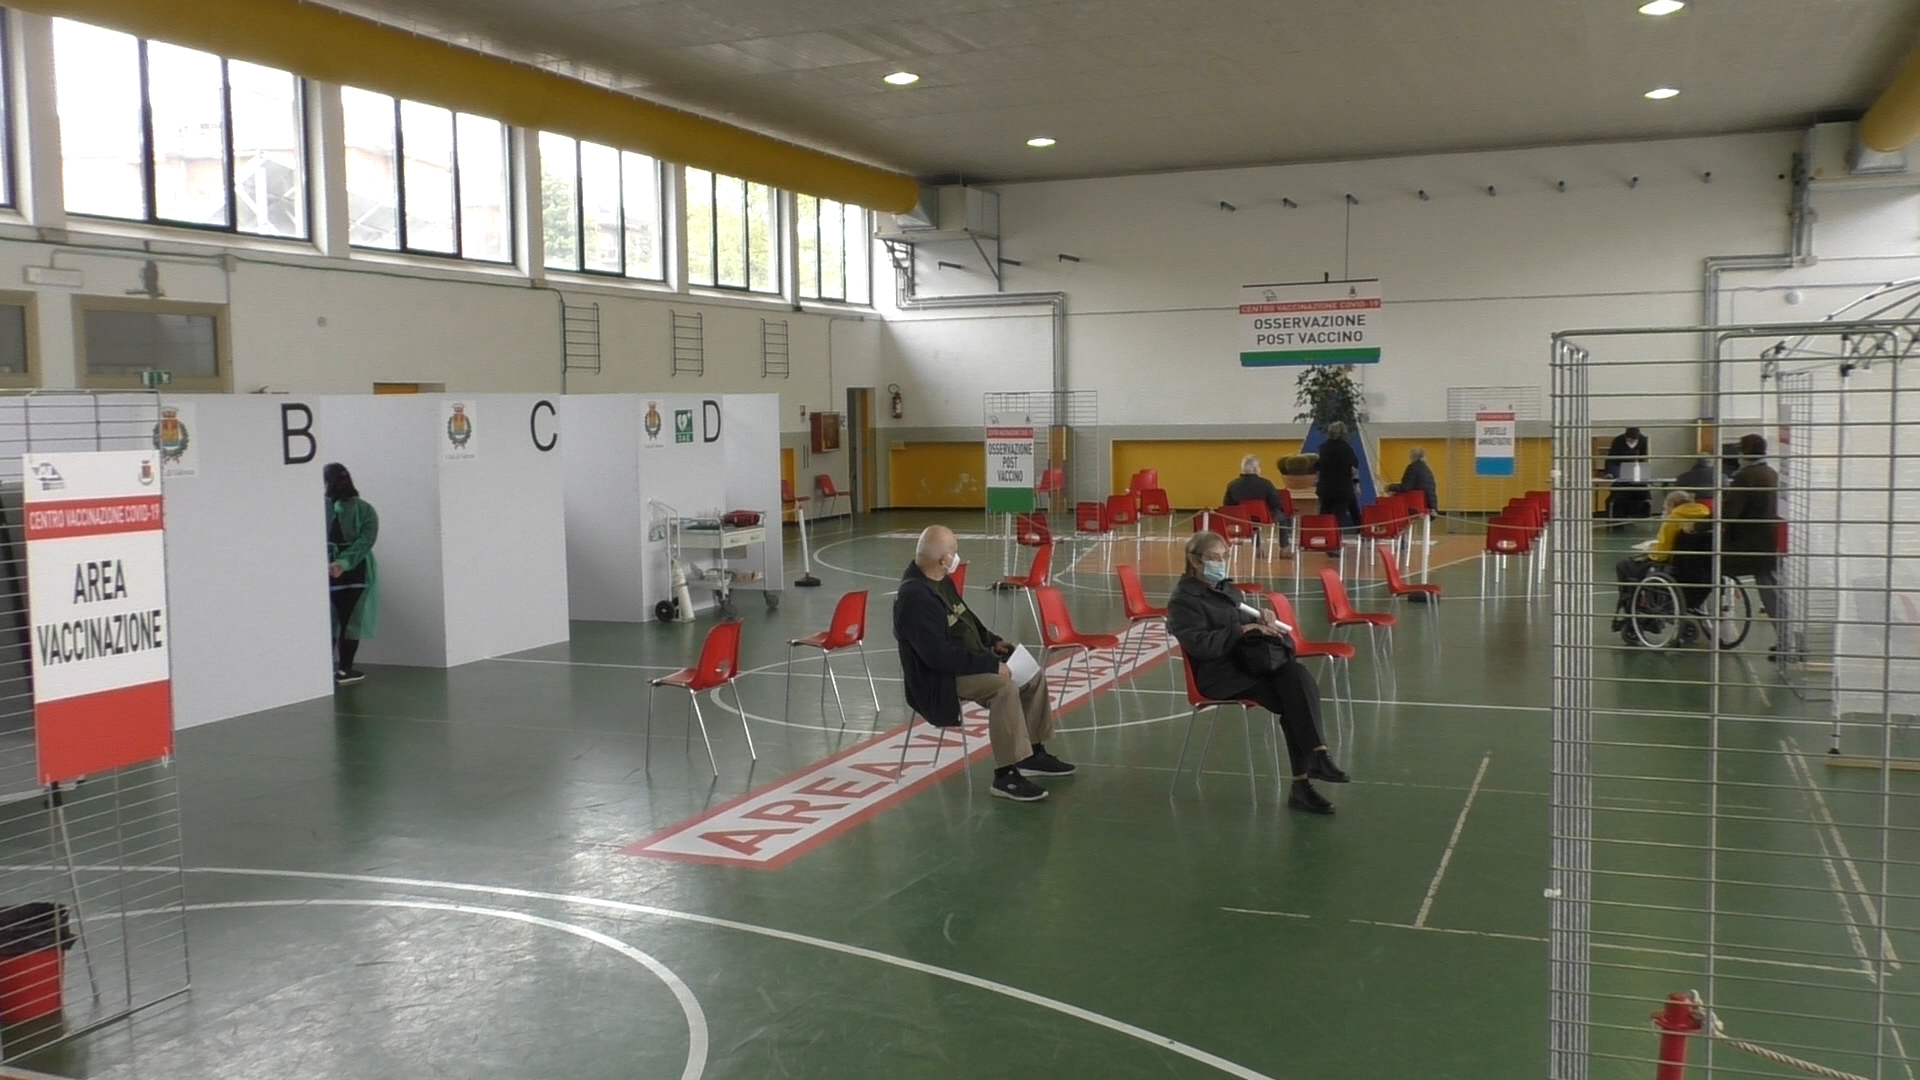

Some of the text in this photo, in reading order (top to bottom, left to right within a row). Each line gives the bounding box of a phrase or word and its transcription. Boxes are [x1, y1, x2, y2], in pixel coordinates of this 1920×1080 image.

[1241, 300, 1379, 313] CENTRO VACCINAZIONE COVID-19
[1254, 314, 1366, 329] OSSERVAZIONE
[1257, 330, 1363, 345] POST VACCINO
[281, 402, 317, 465] B
[530, 400, 558, 452] C
[702, 400, 722, 442] D
[988, 443, 1032, 455] OSSERVAZIONE
[1002, 456, 1018, 469] POST
[997, 470, 1023, 482] VACCINO
[29, 503, 160, 530] CENTRO VACCINAZIONE COVID-19
[73, 559, 128, 604] AREA
[37, 609, 162, 666] VACCINAZIONE
[698, 760, 934, 856] AREA
